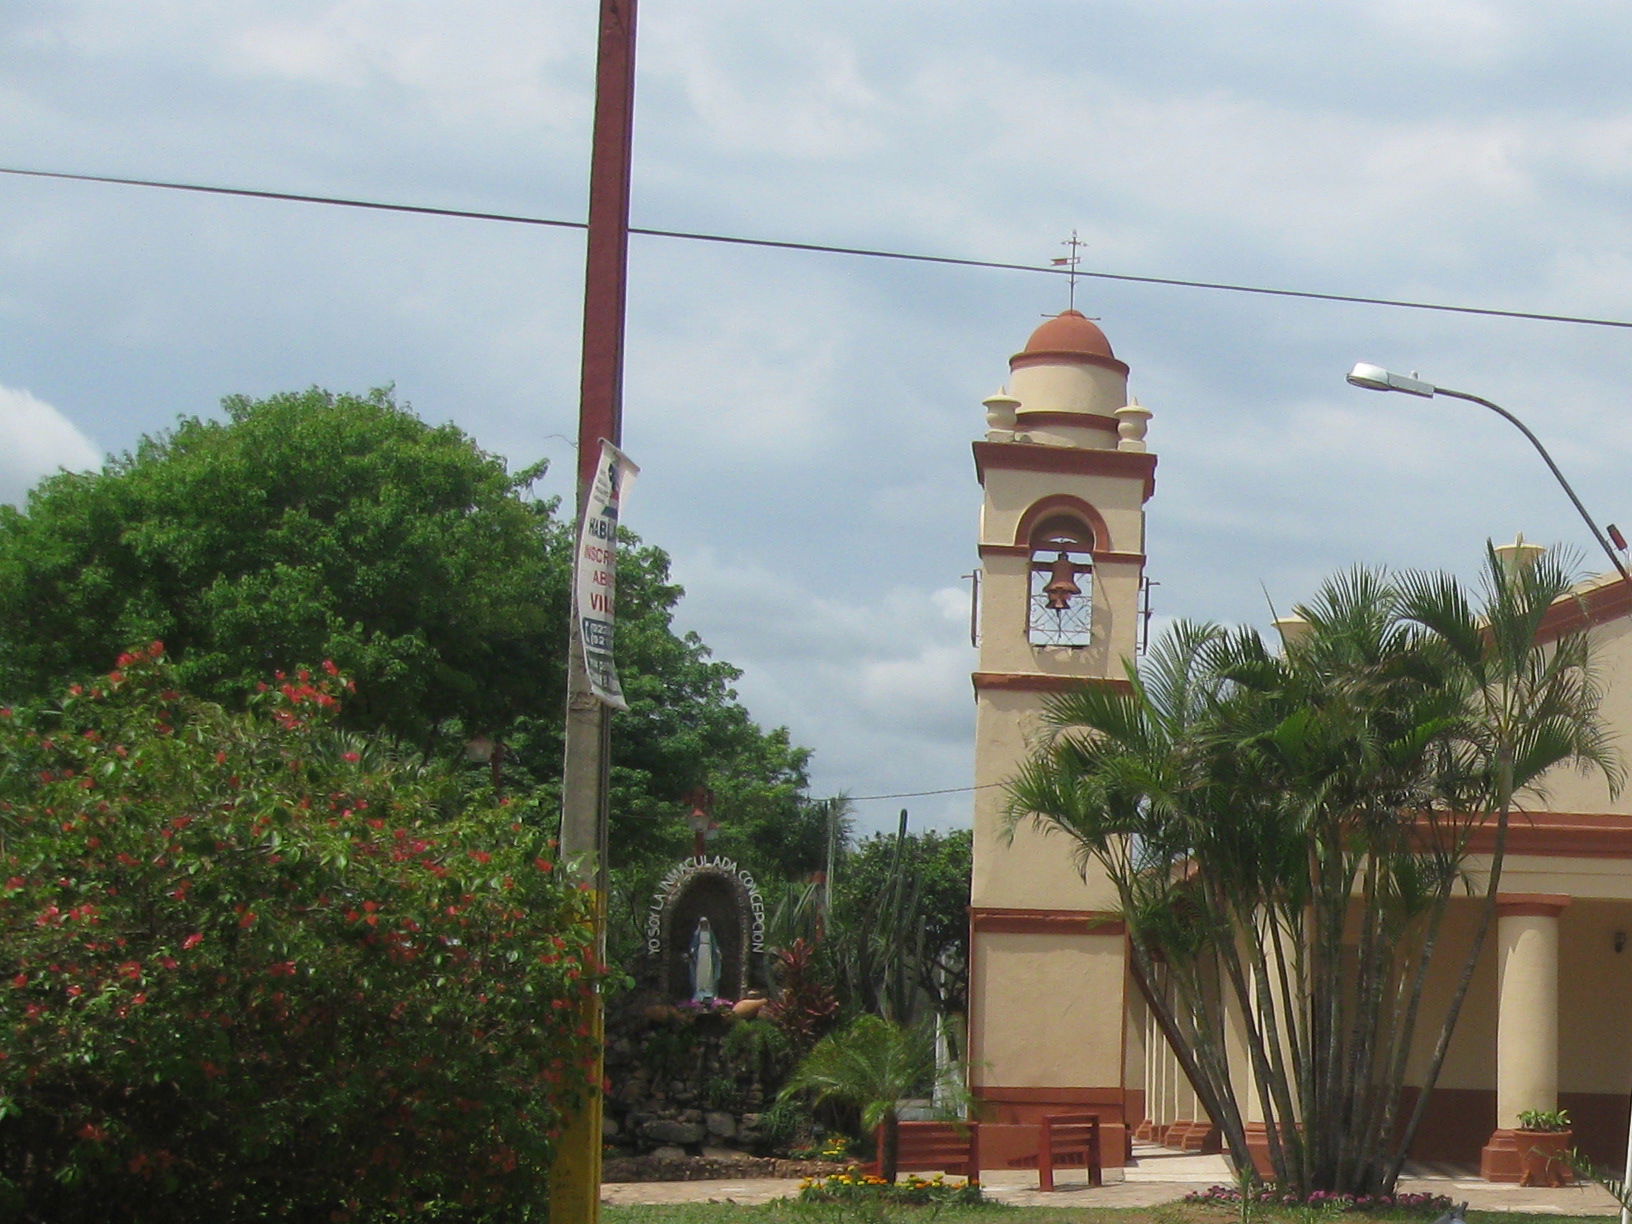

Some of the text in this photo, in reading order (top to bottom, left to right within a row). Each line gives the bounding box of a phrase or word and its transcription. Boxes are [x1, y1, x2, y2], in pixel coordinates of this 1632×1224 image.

[650, 893, 666, 911] LA
[738, 870, 765, 953] CONCEPCION
[648, 911, 660, 937] SOY
[648, 938, 660, 955] YO
